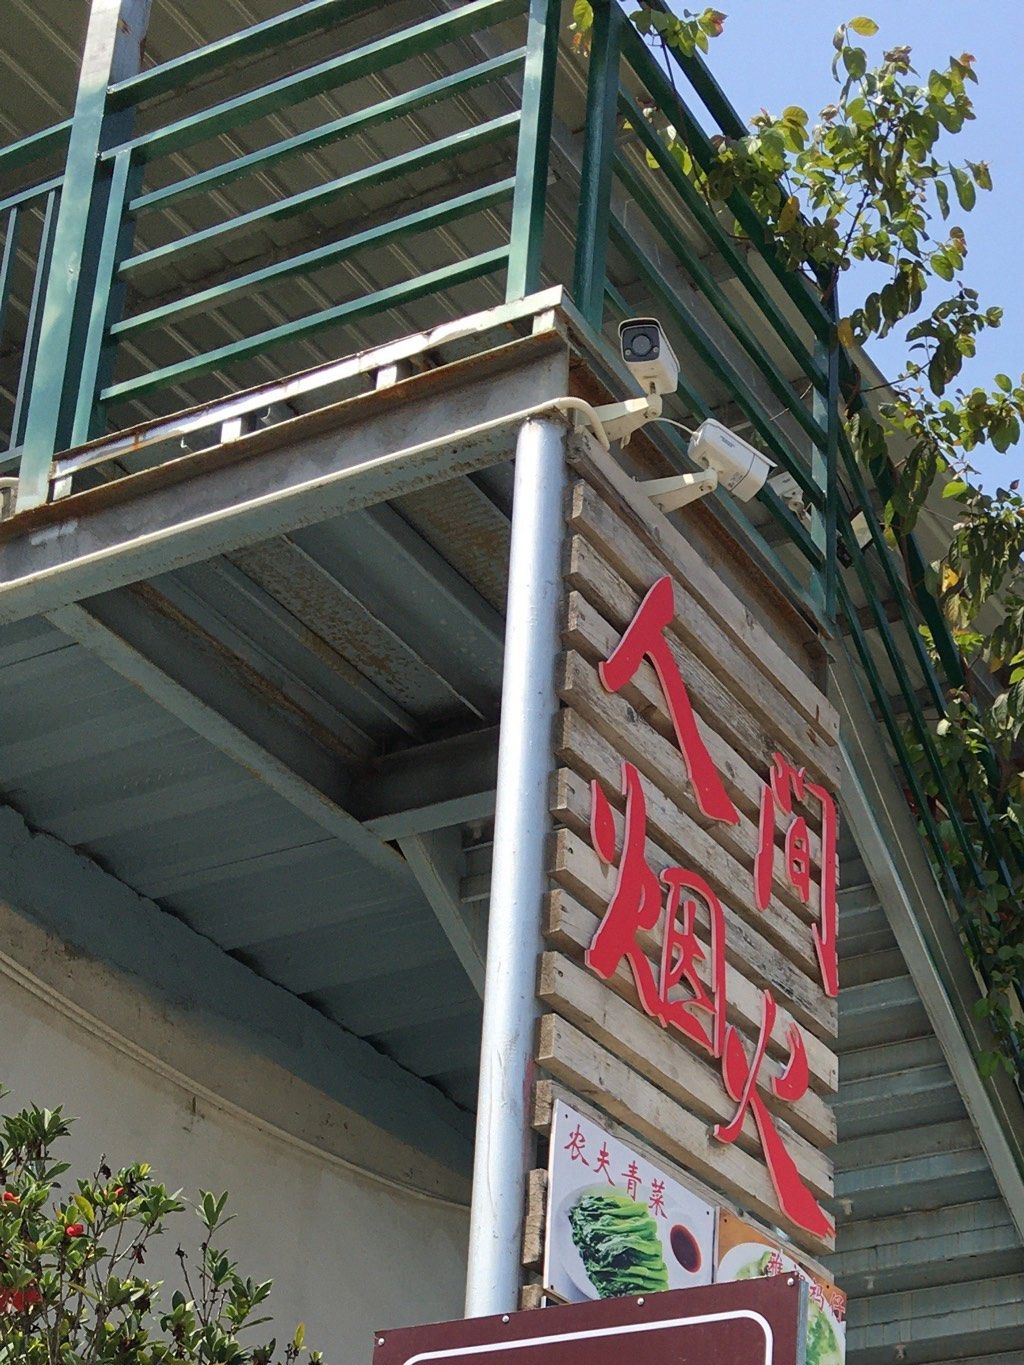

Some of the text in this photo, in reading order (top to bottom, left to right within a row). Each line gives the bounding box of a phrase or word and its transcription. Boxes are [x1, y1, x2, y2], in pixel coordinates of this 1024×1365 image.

[598, 574, 840, 998] 人间
[564, 1123, 668, 1219] 农夫青菜
[584, 760, 838, 1240] 烟火
